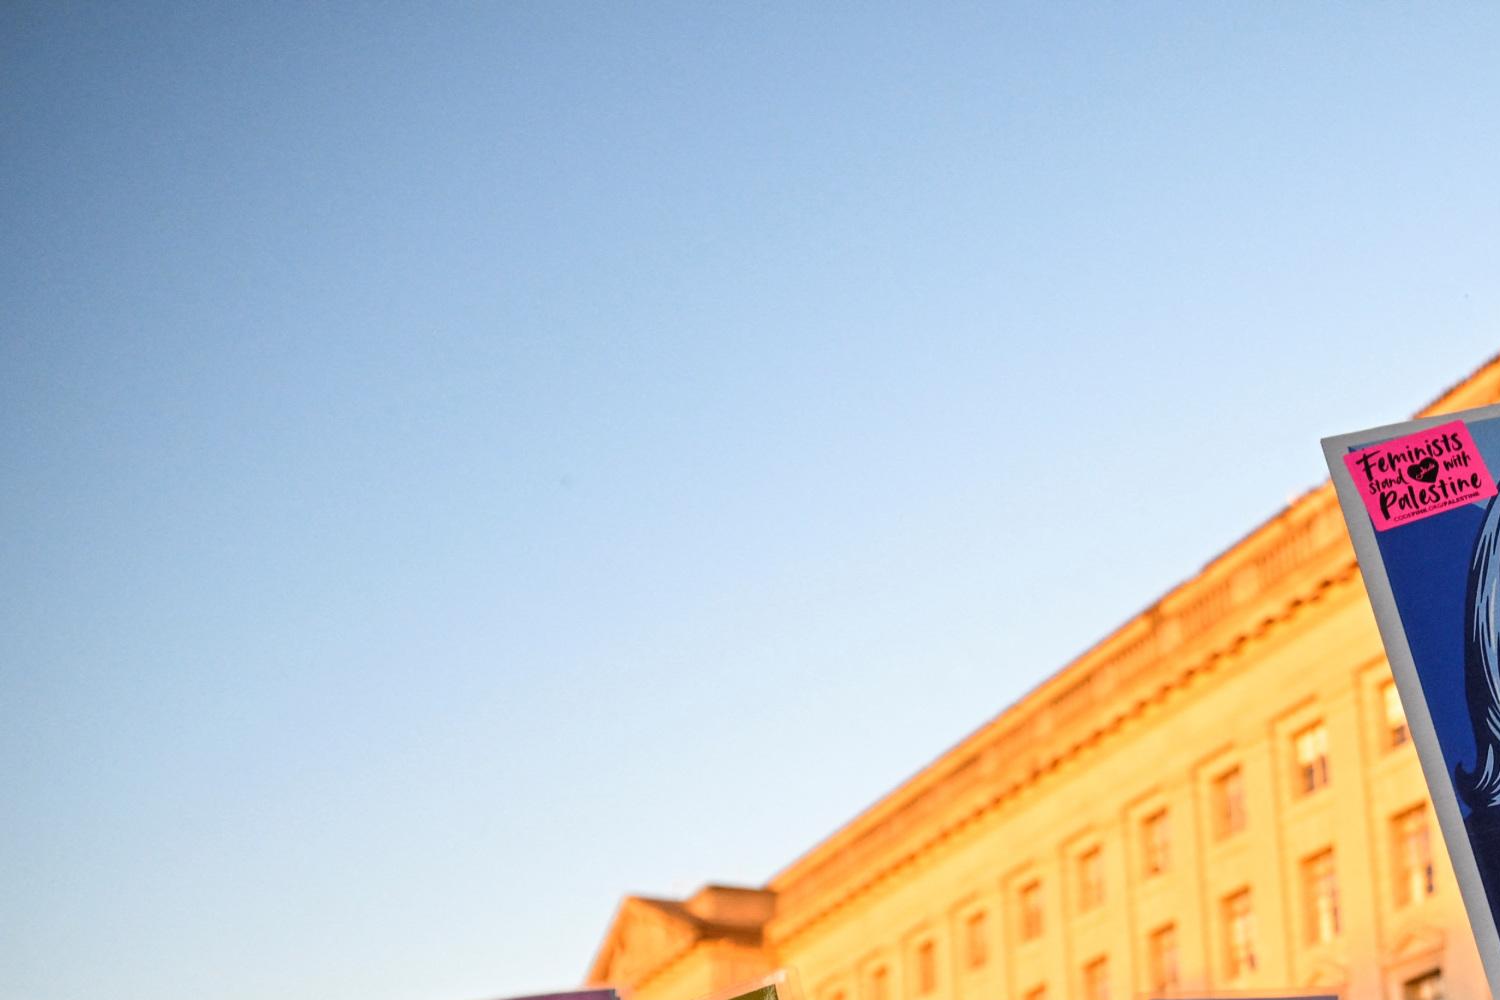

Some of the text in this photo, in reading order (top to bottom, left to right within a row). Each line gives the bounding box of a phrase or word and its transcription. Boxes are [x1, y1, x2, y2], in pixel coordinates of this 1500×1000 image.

[1356, 433, 1463, 481] Feminists
[1368, 468, 1409, 495] stand
[1443, 450, 1472, 471] with
[1379, 473, 1482, 520] Palestine
